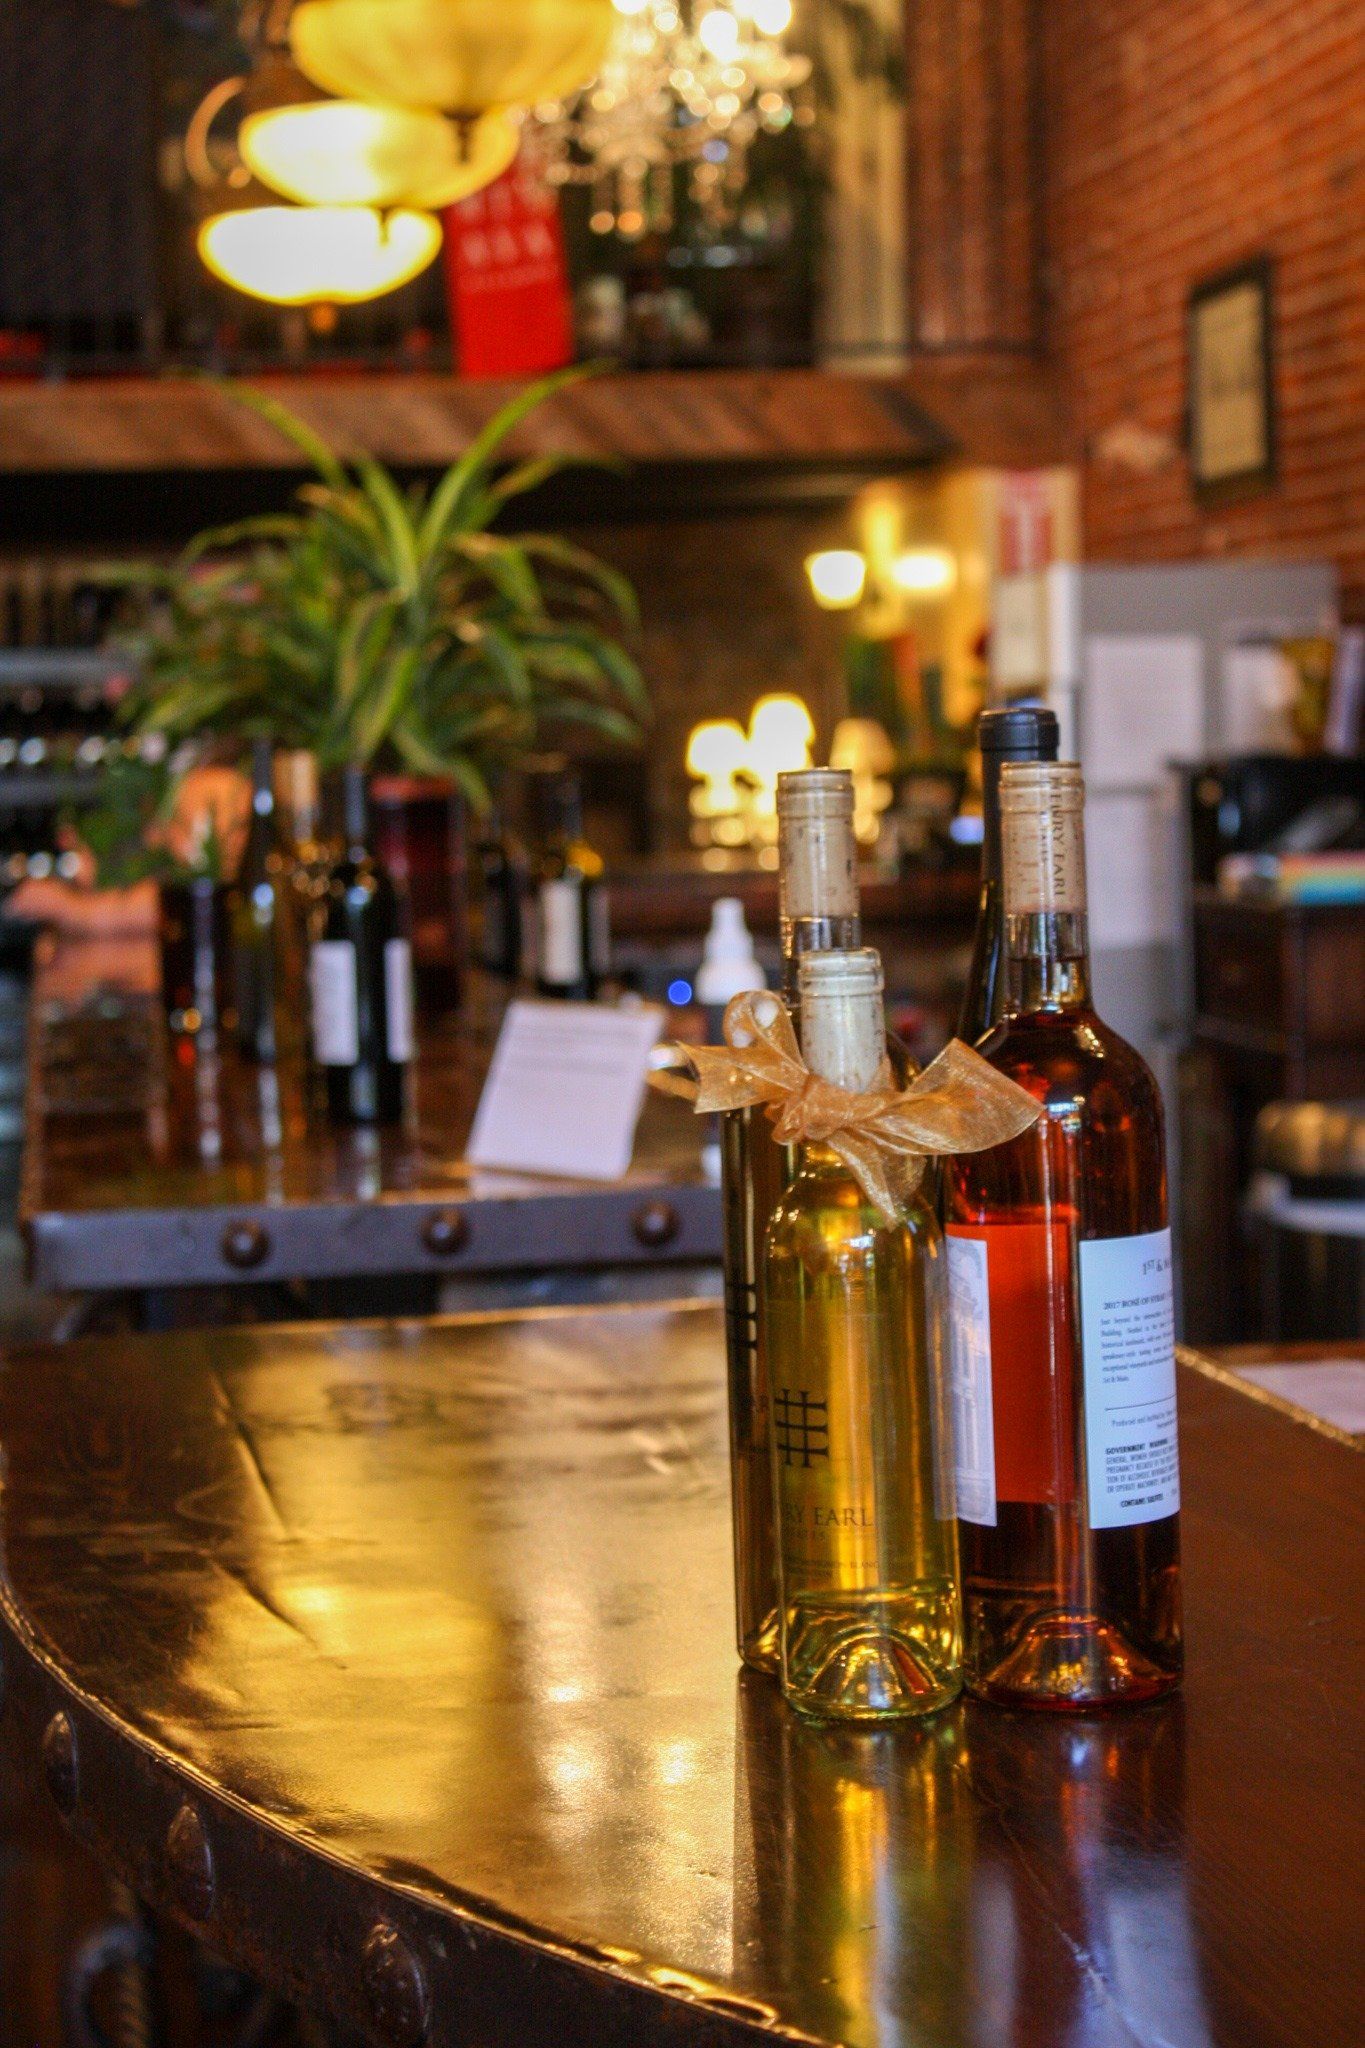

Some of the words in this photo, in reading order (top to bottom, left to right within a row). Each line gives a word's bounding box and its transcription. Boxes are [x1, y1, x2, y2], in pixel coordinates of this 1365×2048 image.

[1103, 1301, 1120, 1310] 2017
[1106, 1444, 1145, 1455] GOVERNMENT
[814, 1506, 873, 1527] EARL
